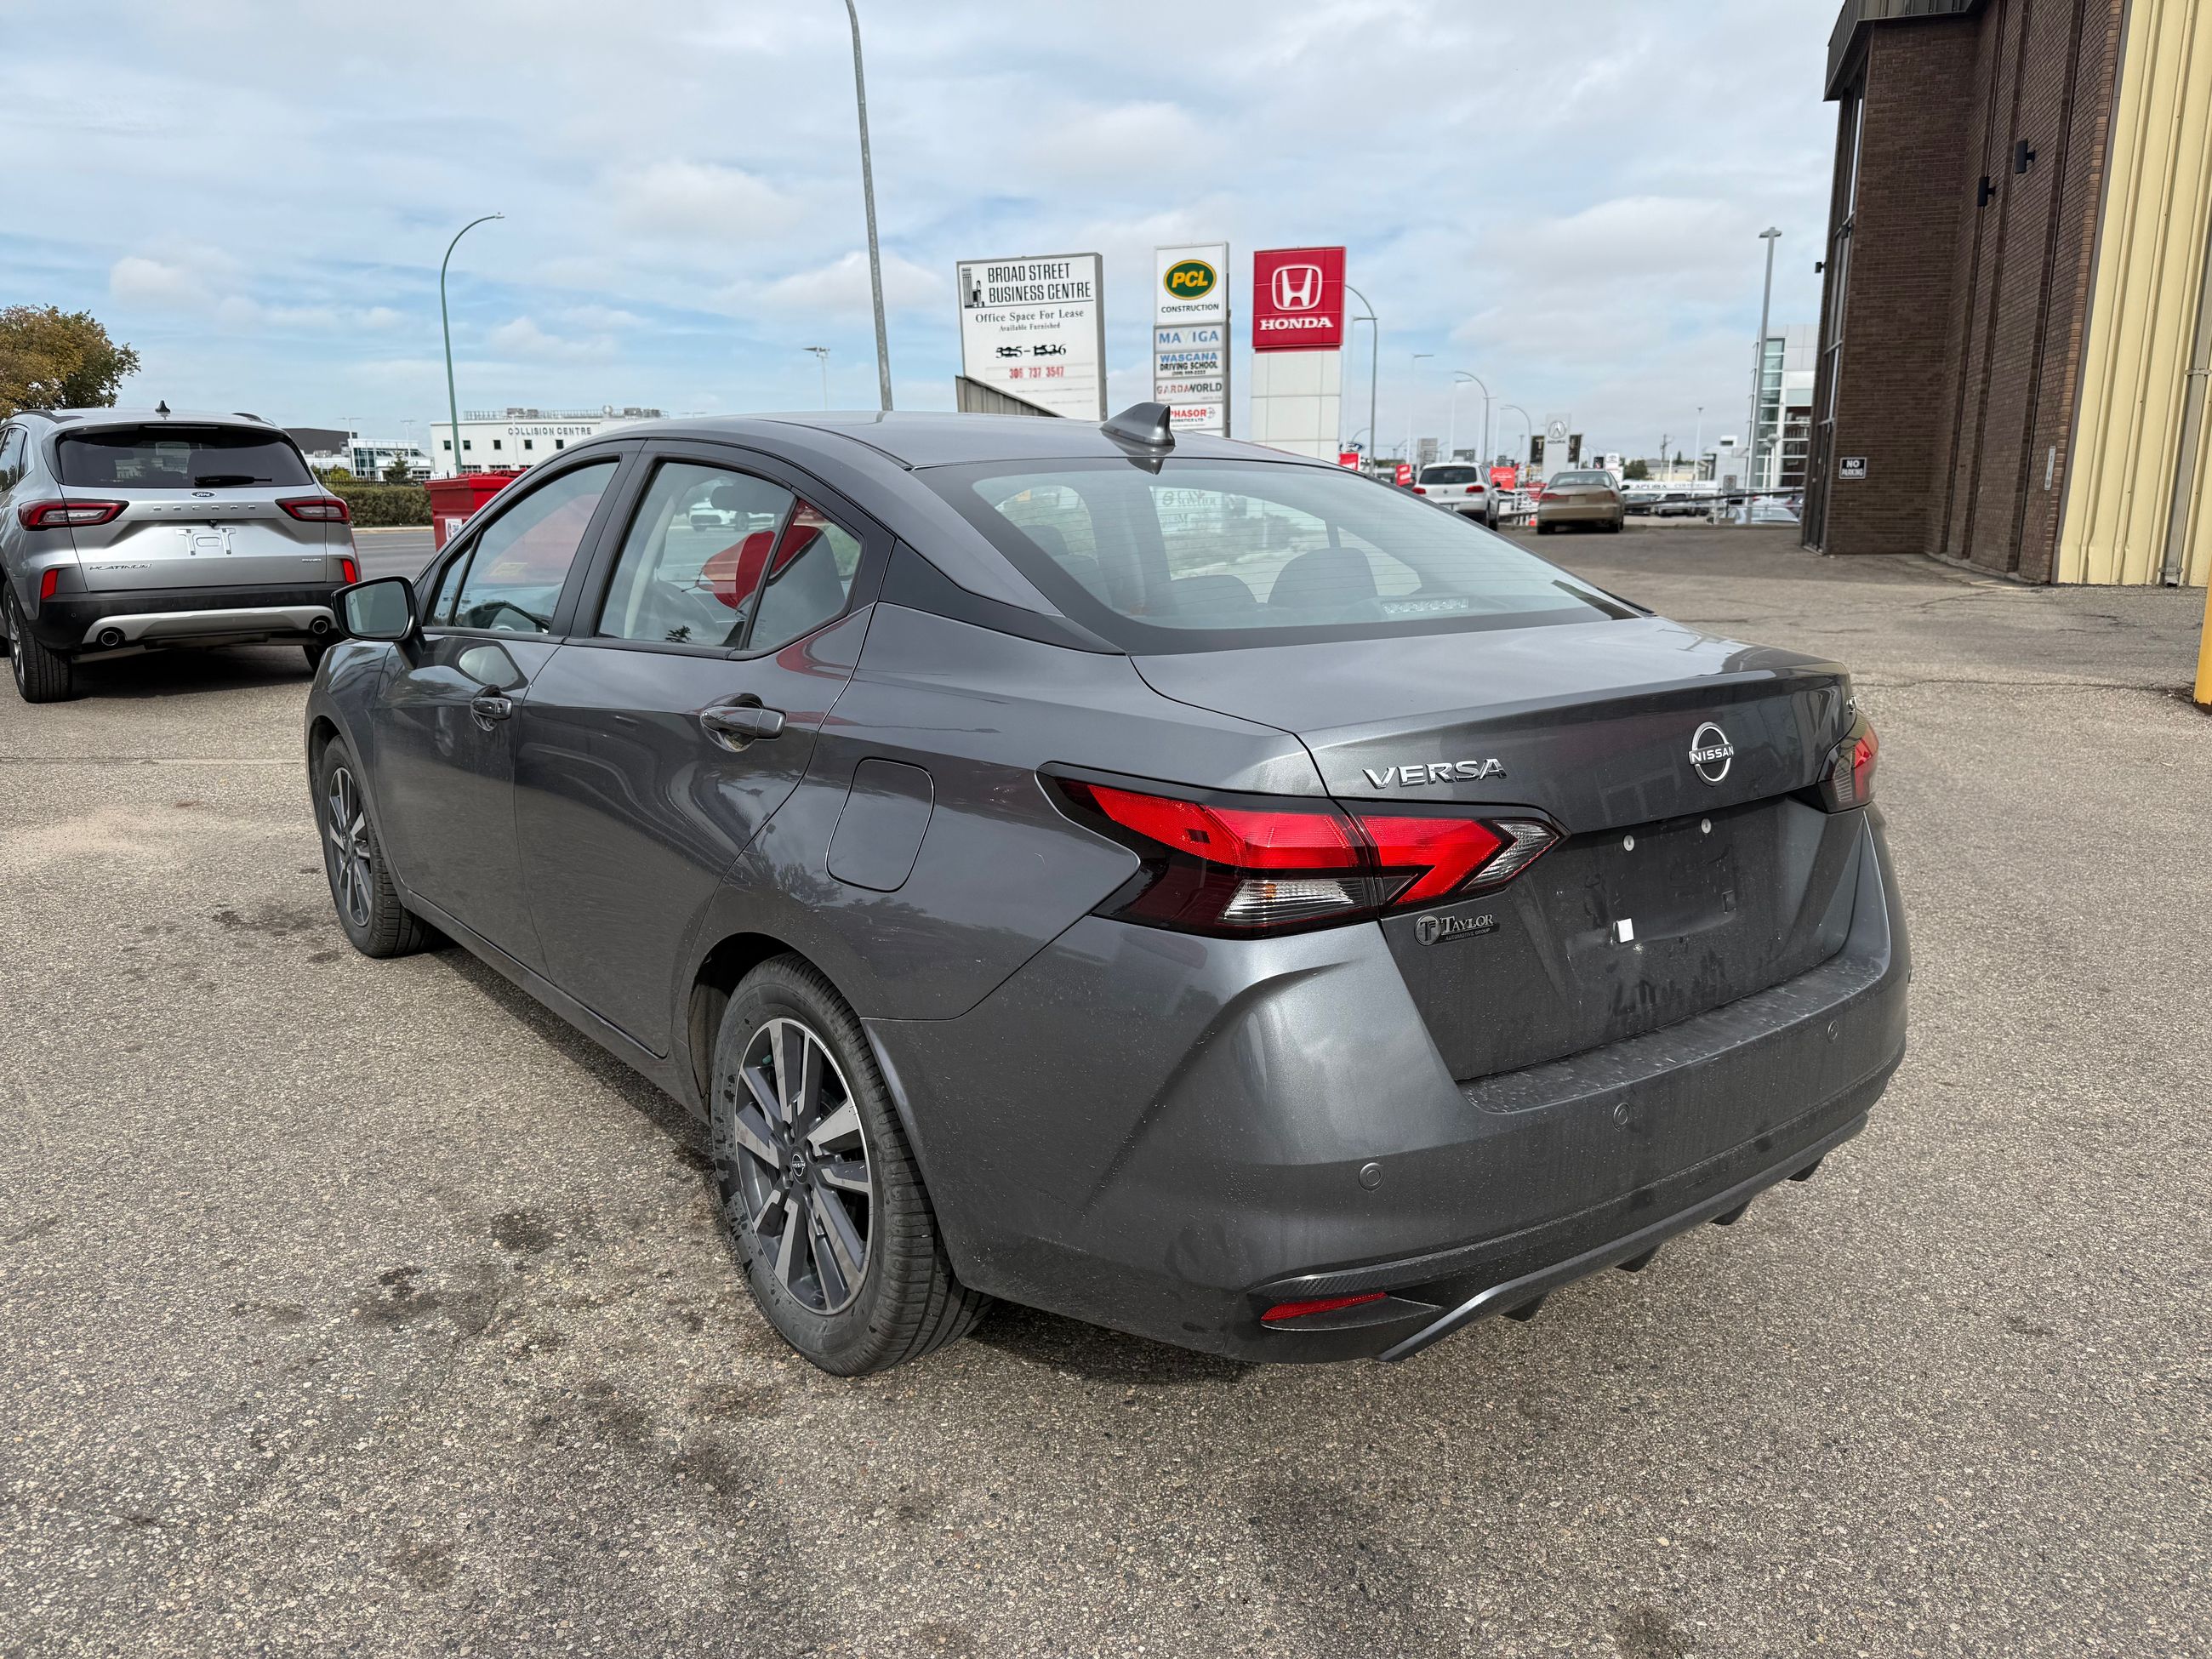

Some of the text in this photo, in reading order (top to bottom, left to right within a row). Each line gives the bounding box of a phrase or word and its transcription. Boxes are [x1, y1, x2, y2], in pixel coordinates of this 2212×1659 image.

[988, 263, 1070, 283] BROAD STREET
[1172, 271, 1208, 288] PCL
[989, 282, 1091, 304] BUSINESS CENTRE
[975, 309, 1084, 323] Office Space For Lease
[1161, 304, 1219, 313] CONSTRUCTION
[1259, 316, 1333, 331] HONDA
[1160, 353, 1217, 362] WASCANA
[1160, 361, 1218, 371] DRIVING SCHOOL
[508, 427, 592, 436] COLLISION CENTRE
[1690, 745, 1734, 763] NISSAN
[1361, 758, 1508, 790] VERSA
[1440, 914, 1494, 935] TAYLOR
